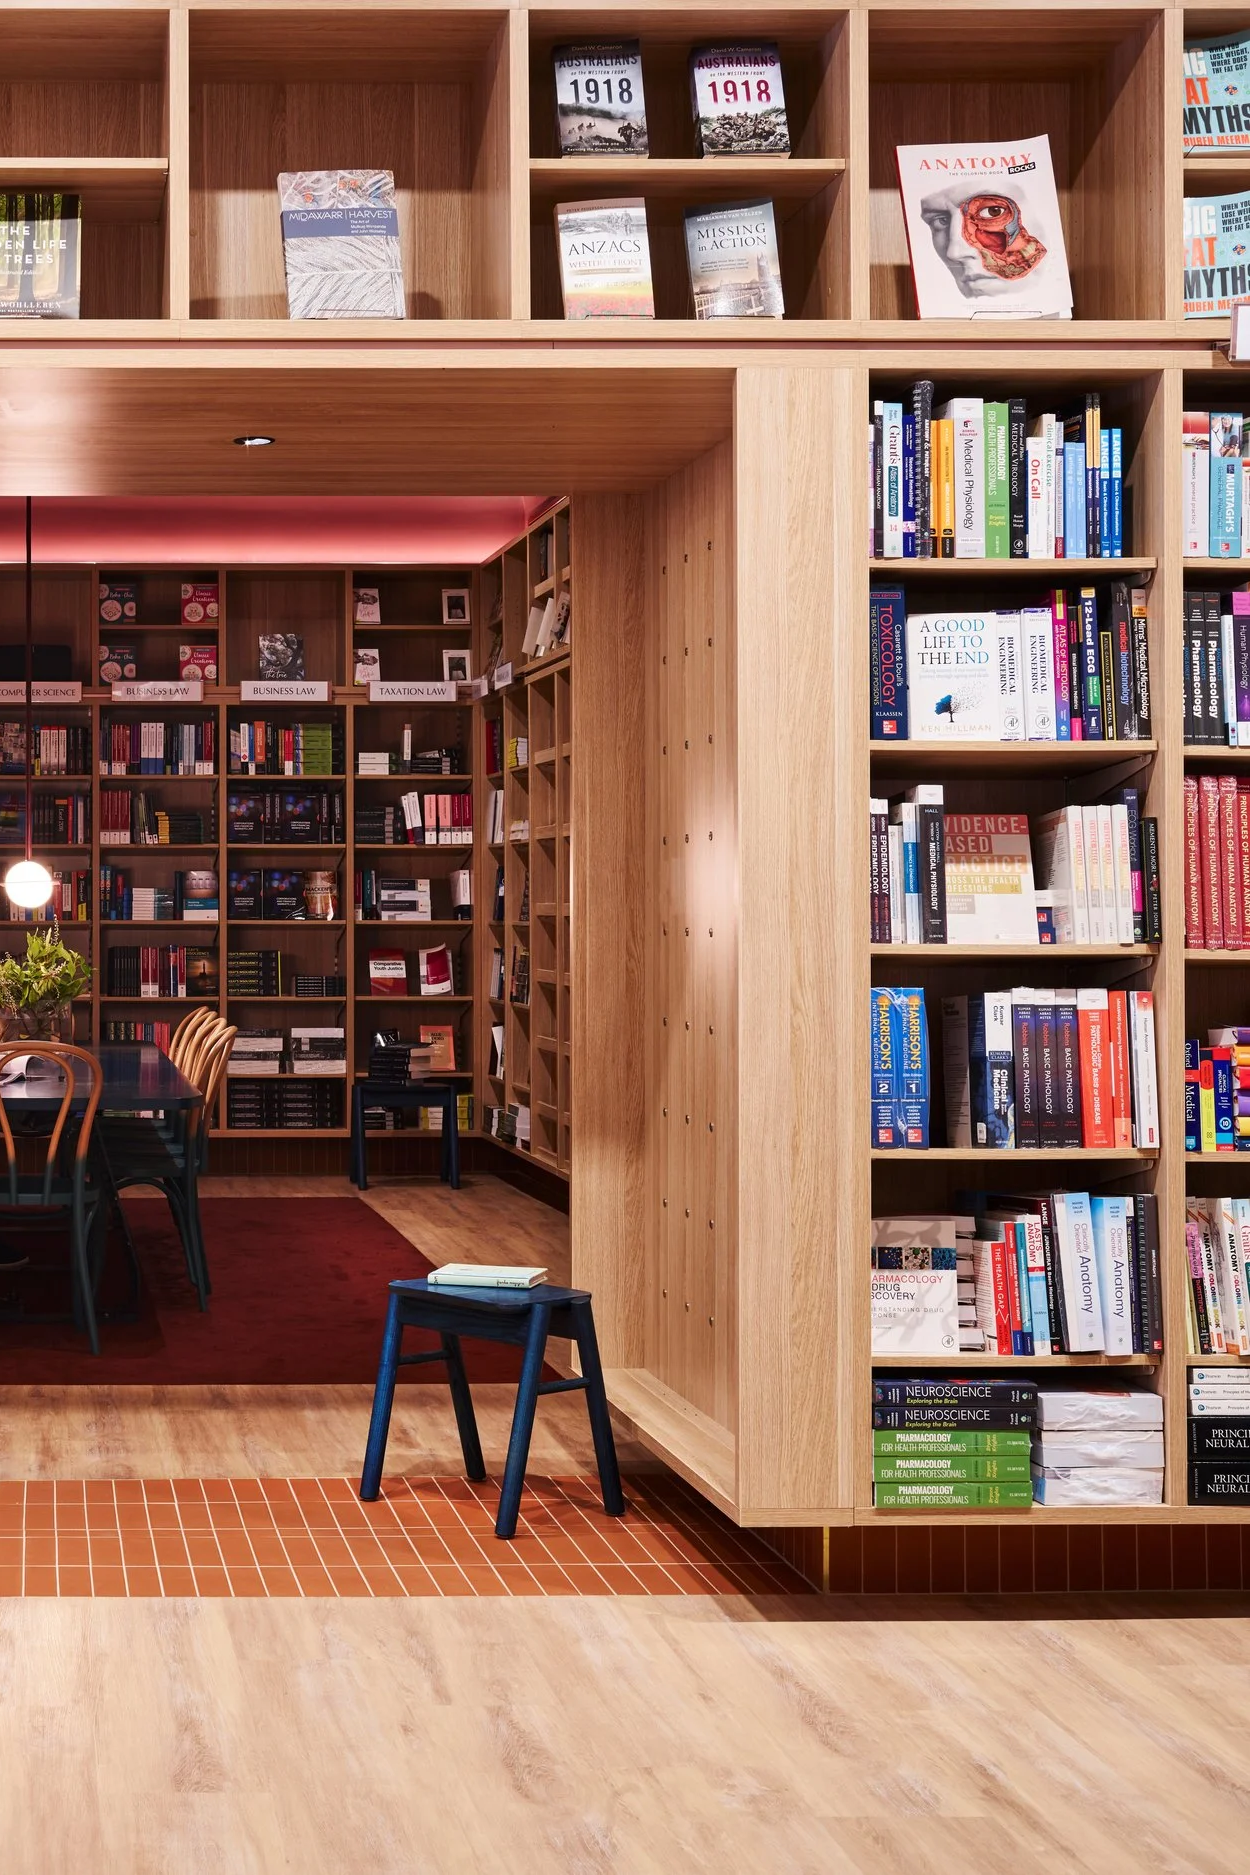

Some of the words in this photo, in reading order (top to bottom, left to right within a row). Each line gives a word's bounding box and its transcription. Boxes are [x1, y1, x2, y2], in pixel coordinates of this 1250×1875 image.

[1225, 47, 1249, 57] WEIGHT,
[559, 53, 638, 68] AUSTRALIANS
[698, 56, 776, 70] AUSTRALIANS
[1211, 59, 1230, 67] WHERE
[1233, 55, 1248, 64] DOES
[1235, 63, 1247, 71] GO?
[570, 78, 633, 104] 1918
[708, 79, 771, 104] 1918
[1184, 137, 1214, 146] RUBEN
[919, 153, 1032, 170] ANATOMY
[1009, 163, 1035, 174] ROCKS
[350, 210, 393, 219] HARVEST
[1222, 217, 1242, 225] WHERE
[0, 226, 30, 235] THE
[697, 223, 765, 240] MISSING
[33, 240, 67, 249] LIFE
[568, 239, 641, 256] ANZACS
[710, 235, 767, 251] ACTION
[4, 254, 54, 263] TREES
[964, 439, 973, 477] Medical
[998, 425, 1006, 480] PHARMACOLOGY
[1101, 435, 1109, 469] LANGE
[988, 449, 996, 496] PROFESSIONALS
[1031, 459, 1040, 475] On
[1032, 478, 1041, 499] Call
[963, 480, 974, 530] Physiology
[920, 621, 930, 632] A
[934, 619, 984, 632] GOOD
[1085, 600, 1094, 646] 12-Lead
[924, 636, 956, 649] LIFE
[959, 636, 982, 648] TO
[880, 604, 895, 706] TOXICOLOGY
[918, 652, 951, 665] THE
[955, 652, 989, 664] END
[1087, 649, 1095, 673] ECG
[999, 637, 1007, 695] ENGINEERING
[1007, 636, 1016, 695] BIOMEDICAL
[1192, 640, 1203, 718] Pharmacology
[43, 688, 76, 697] SCIENCE
[126, 687, 169, 696] BUSINESS
[171, 687, 190, 696] LAW
[253, 687, 293, 696] BUSINESS
[295, 687, 317, 696] LAW
[379, 687, 424, 696] TAXATION
[426, 687, 447, 696] LAW
[1207, 793, 1216, 838] PRINCIPLES
[929, 842, 937, 871] MEDICAL
[880, 835, 889, 895] EPIDEMIOLOGY
[989, 876, 1019, 884] HEALTH
[930, 872, 938, 911] PHYSIOLOGY
[879, 1002, 891, 1070] HARRISON'S
[908, 1002, 921, 1070] HARRISON'S
[879, 1083, 889, 1093] 2
[1000, 1069, 1008, 1103] Clinical
[1023, 1070, 1031, 1114] PATHOLOGY
[1066, 1070, 1074, 1114] PATHOLOGY
[1186, 1085, 1195, 1121] Medical
[1080, 1255, 1093, 1314] Anatomy
[1113, 1260, 1124, 1318] Anatomy
[906, 1387, 991, 1397] NEUROSCIENCE
[905, 1410, 990, 1420] NEUROSCIENCE
[896, 1434, 951, 1442] PHARMACOLOGY
[1205, 1439, 1249, 1448] NEURAL
[881, 1444, 893, 1452] FOR
[895, 1444, 917, 1452] HEALTH
[919, 1444, 966, 1452] PROFESSIONALS
[896, 1460, 951, 1468] PHARMACOLOGY
[881, 1470, 893, 1478] FOR
[895, 1470, 917, 1478] HEALTH
[919, 1470, 966, 1478] PROFESSIONALS
[899, 1486, 953, 1494] PHARMACOLOGY
[884, 1496, 896, 1504] FOR
[897, 1496, 919, 1504] HEALTH
[921, 1496, 969, 1504] PROFESSIONALS
